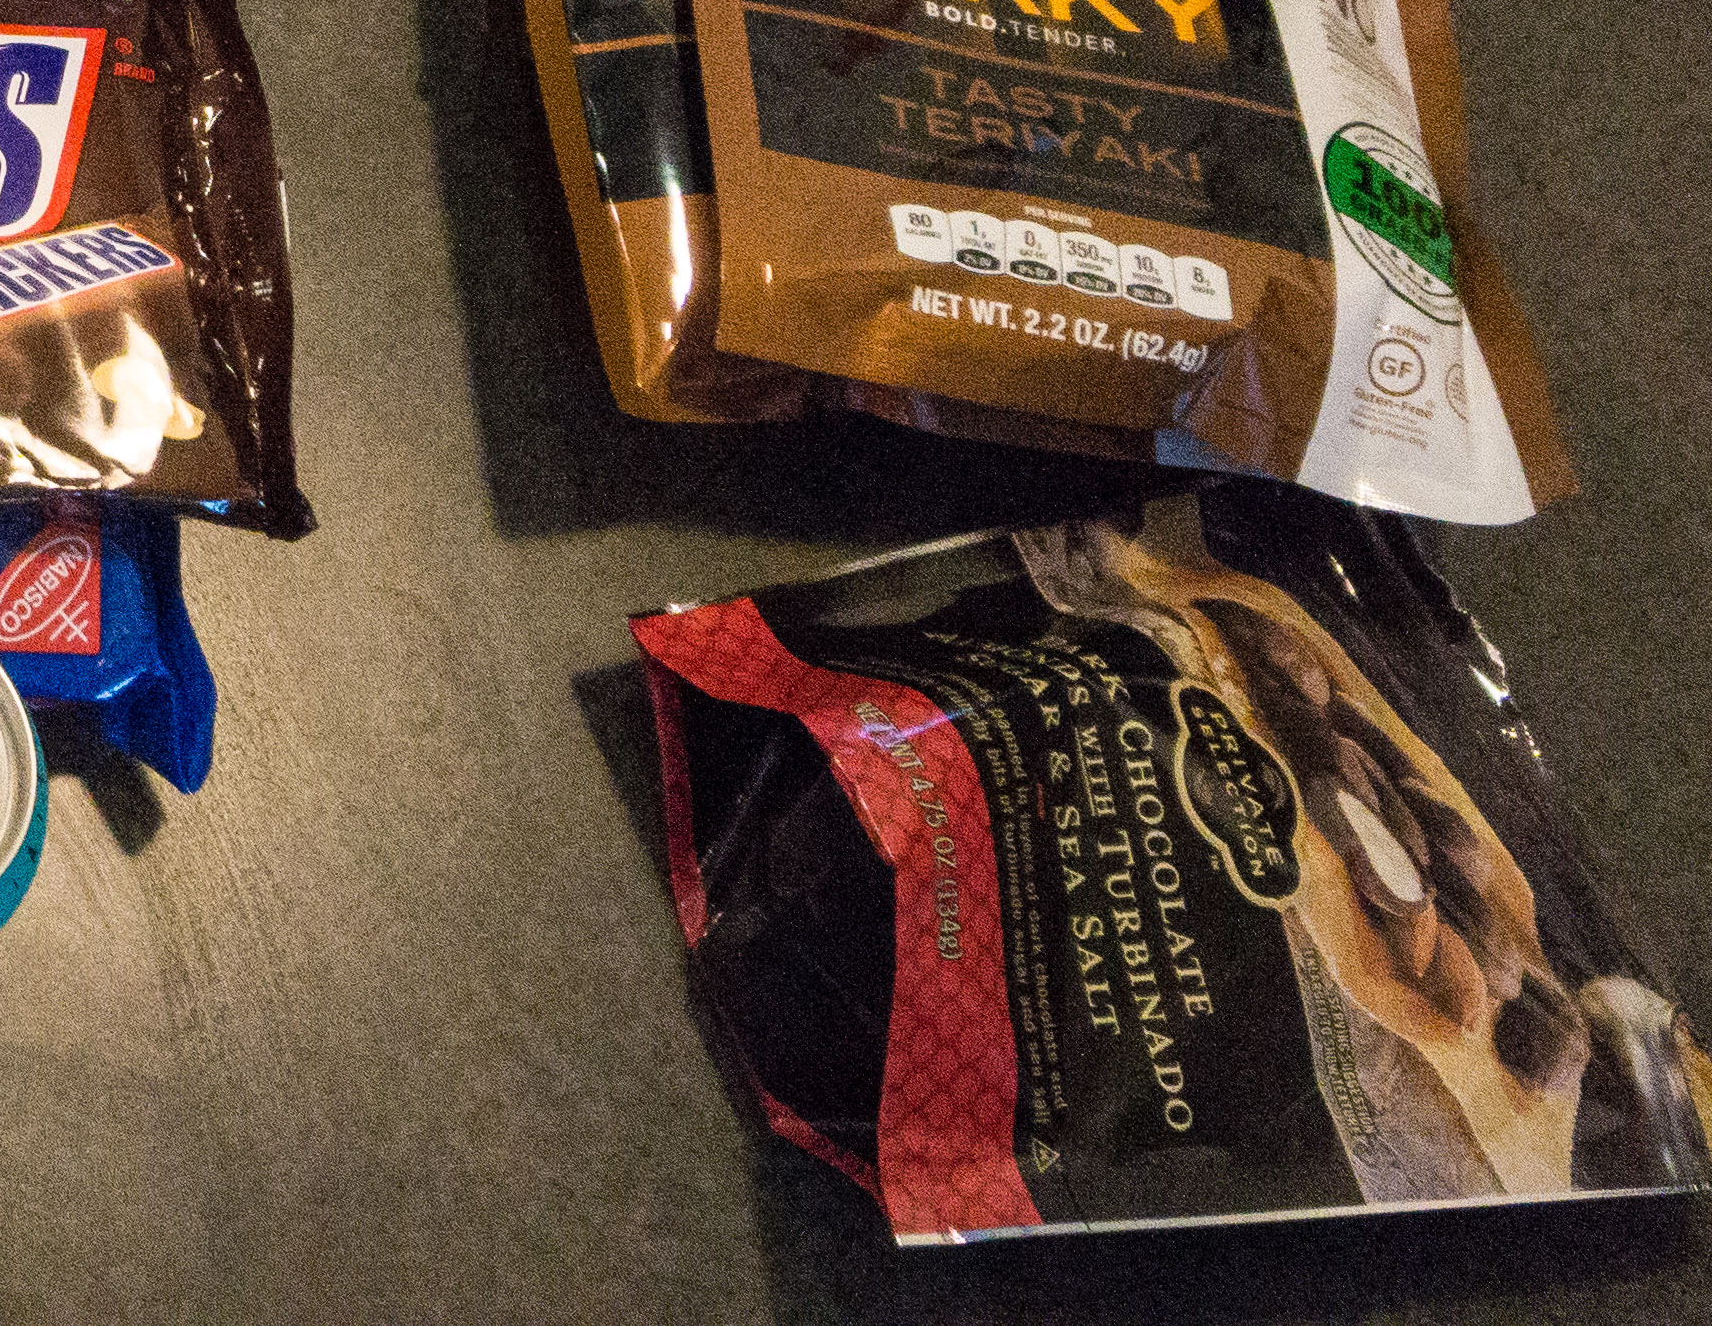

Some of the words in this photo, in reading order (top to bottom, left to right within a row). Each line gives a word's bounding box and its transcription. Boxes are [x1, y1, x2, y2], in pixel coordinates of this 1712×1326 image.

[112, 62, 156, 84] BRAND
[921, 65, 1144, 132] TASTY
[880, 94, 1203, 183] TERIYAKI
[907, 211, 933, 229] 80
[910, 285, 963, 321] NET
[967, 297, 1018, 332] WT.
[1023, 307, 1067, 343] 2.2
[1074, 317, 1116, 352] OZ.
[1121, 325, 1209, 374] (62.4g)
[1378, 354, 1416, 380] GF
[1050, 747, 1074, 786] &
[1188, 704, 1267, 880] SELECTION
[1206, 708, 1284, 869] PRIVATE
[908, 773, 941, 831] 4.75
[927, 834, 949, 872] OZ
[1053, 799, 1083, 897] SEA
[1116, 715, 1215, 1021] CHOCOLATE
[1066, 913, 1124, 1036] SALT
[1075, 724, 1119, 819] WITH
[1097, 830, 1195, 1136] TURBINADO
